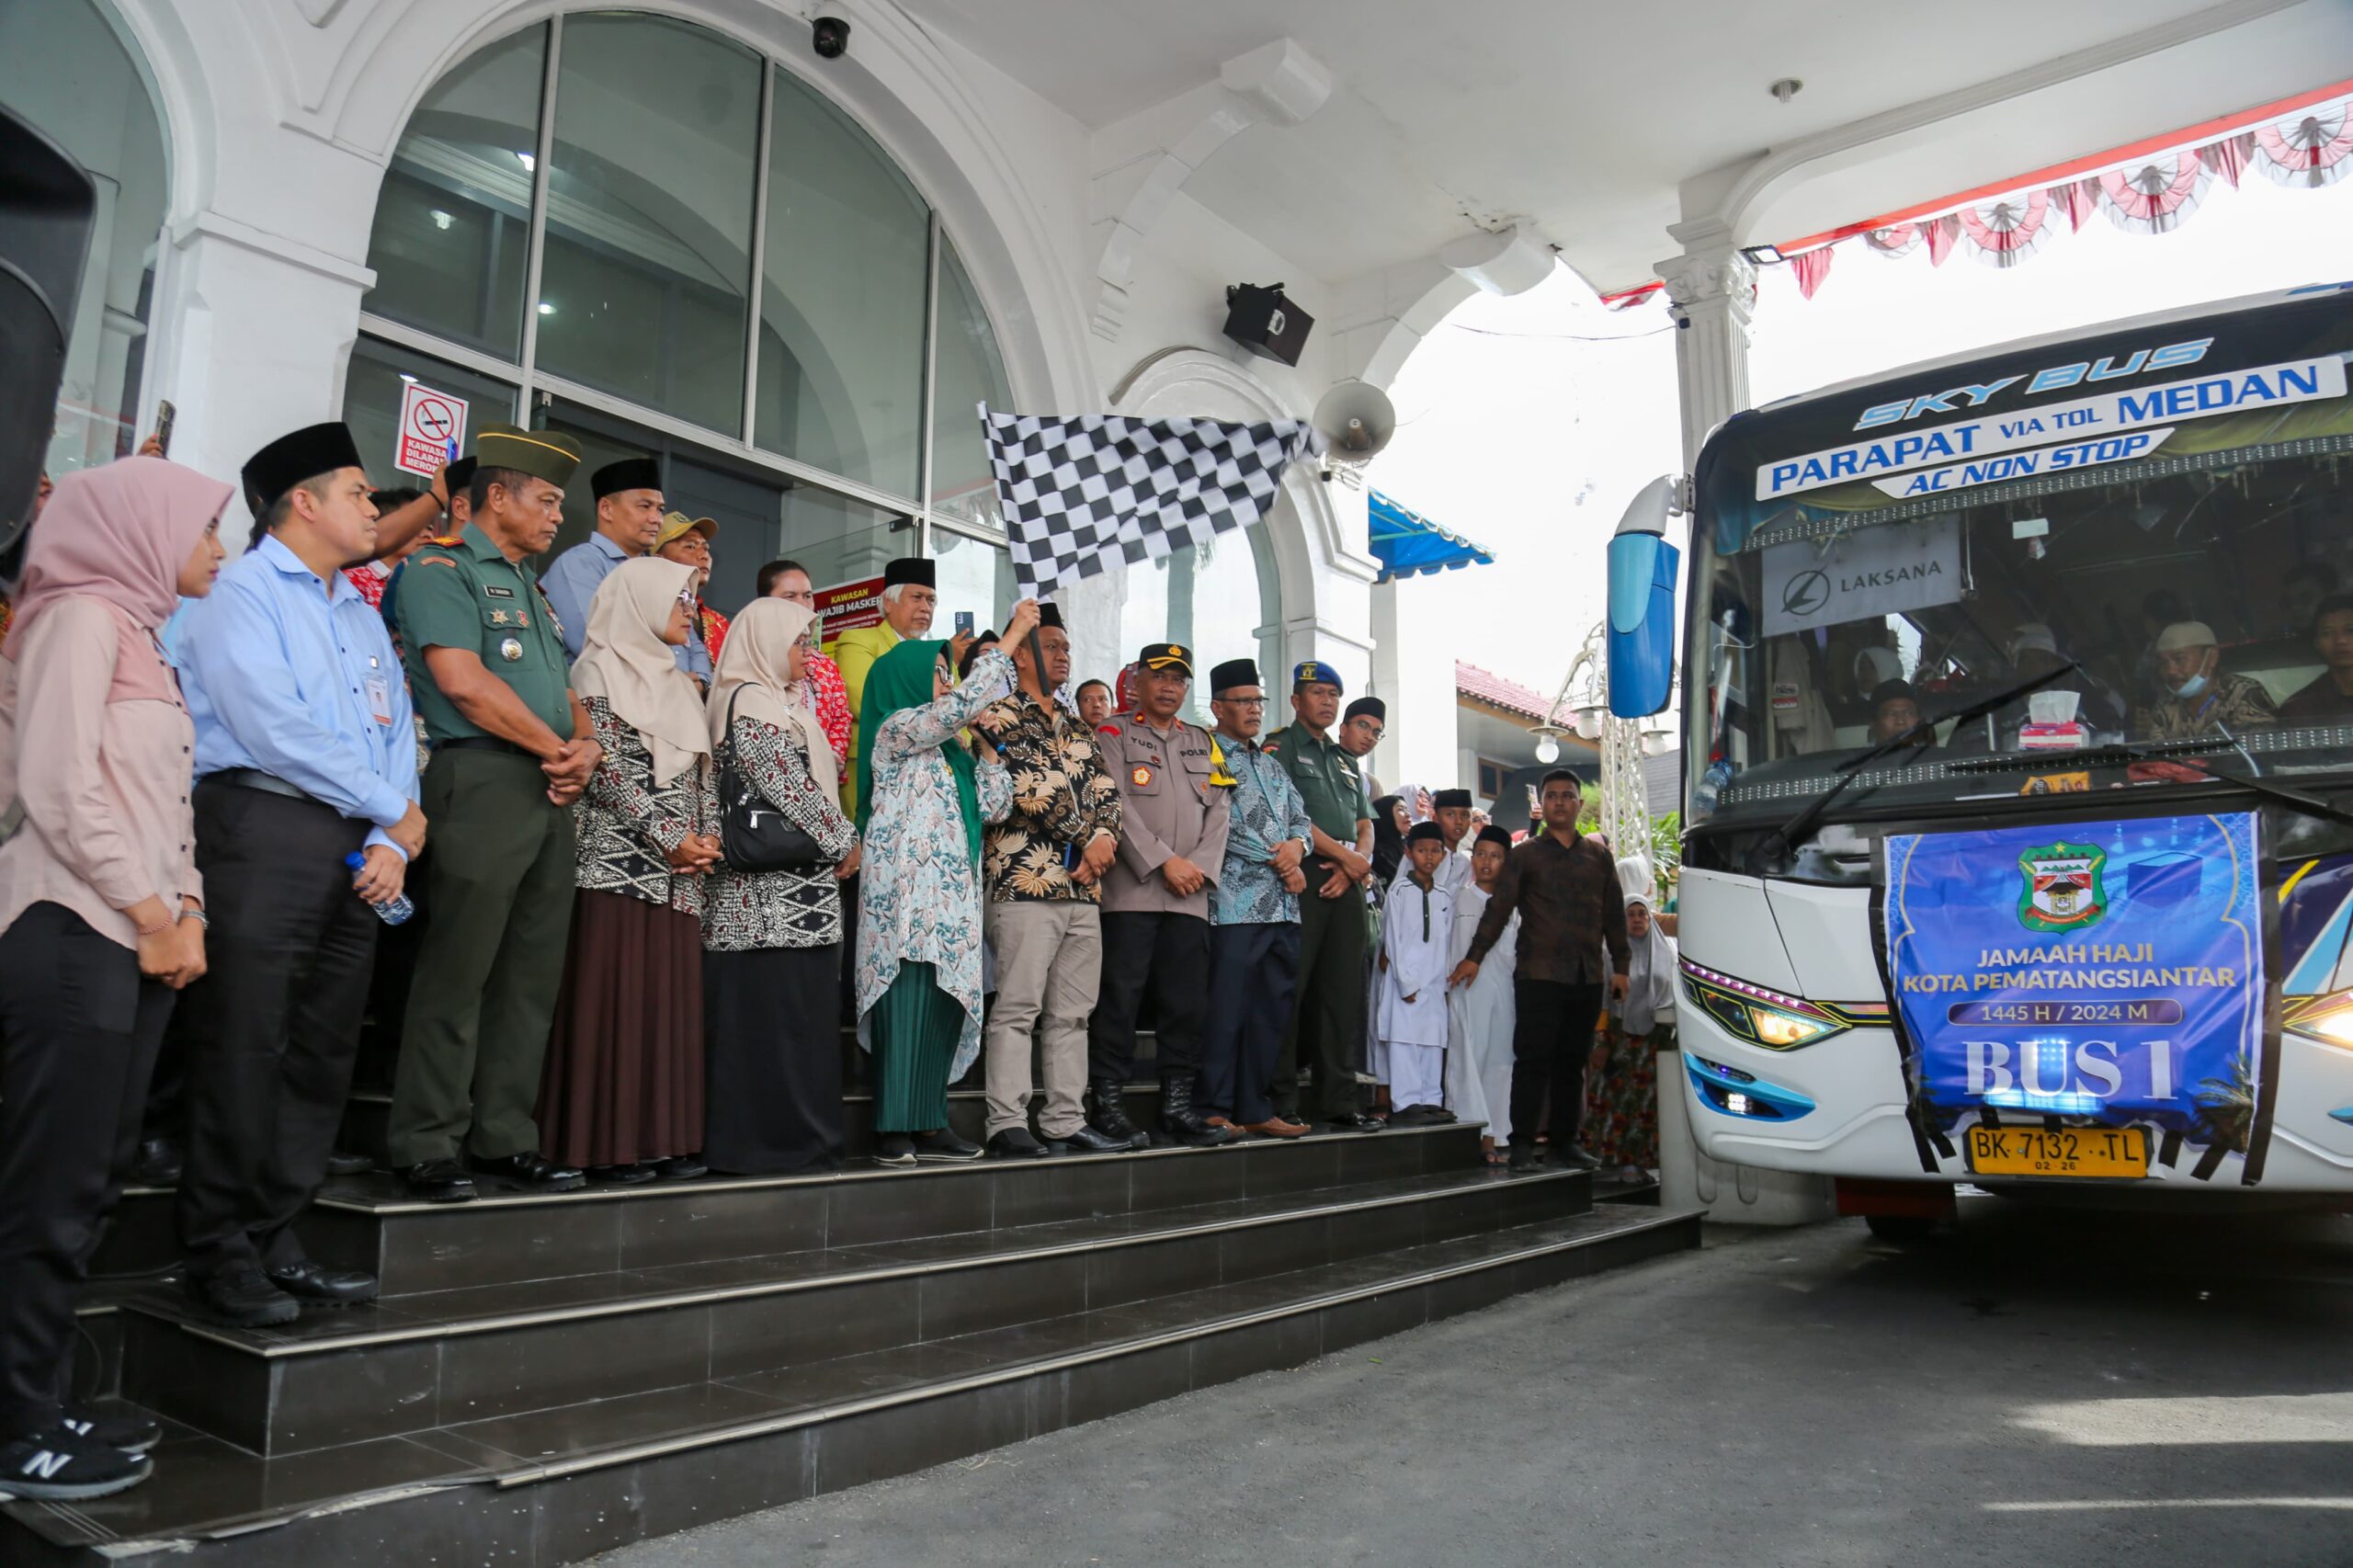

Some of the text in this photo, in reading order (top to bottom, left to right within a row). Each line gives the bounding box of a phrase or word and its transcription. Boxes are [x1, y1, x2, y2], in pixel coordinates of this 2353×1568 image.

[1852, 337, 2214, 431] SKY BUS
[1772, 365, 2318, 492] PARAPAT VIA TOL MEDAN
[406, 449, 445, 465] DILARA
[407, 440, 447, 459] KAWASA
[404, 458, 439, 473] MEROK
[1904, 434, 2150, 496] AC NON STOP
[1841, 561, 1942, 592] LAKSANA
[817, 596, 882, 618] WAJIB MASKER
[831, 588, 869, 604] KAWASAN
[1131, 736, 1157, 751] YUDI
[1179, 749, 1209, 757] POLRI
[1977, 943, 2154, 968] JAMAAH HAJI
[1903, 967, 2236, 993] KOTA PEMATANGSIANTAR
[1982, 1004, 2147, 1021] 1445 H / 2024 M
[1961, 1040, 2178, 1100] BUS 1
[1976, 1132, 2139, 1162] BK 7132 TL
[2035, 1161, 2076, 1170] 02 26
[21, 1449, 74, 1480] N
